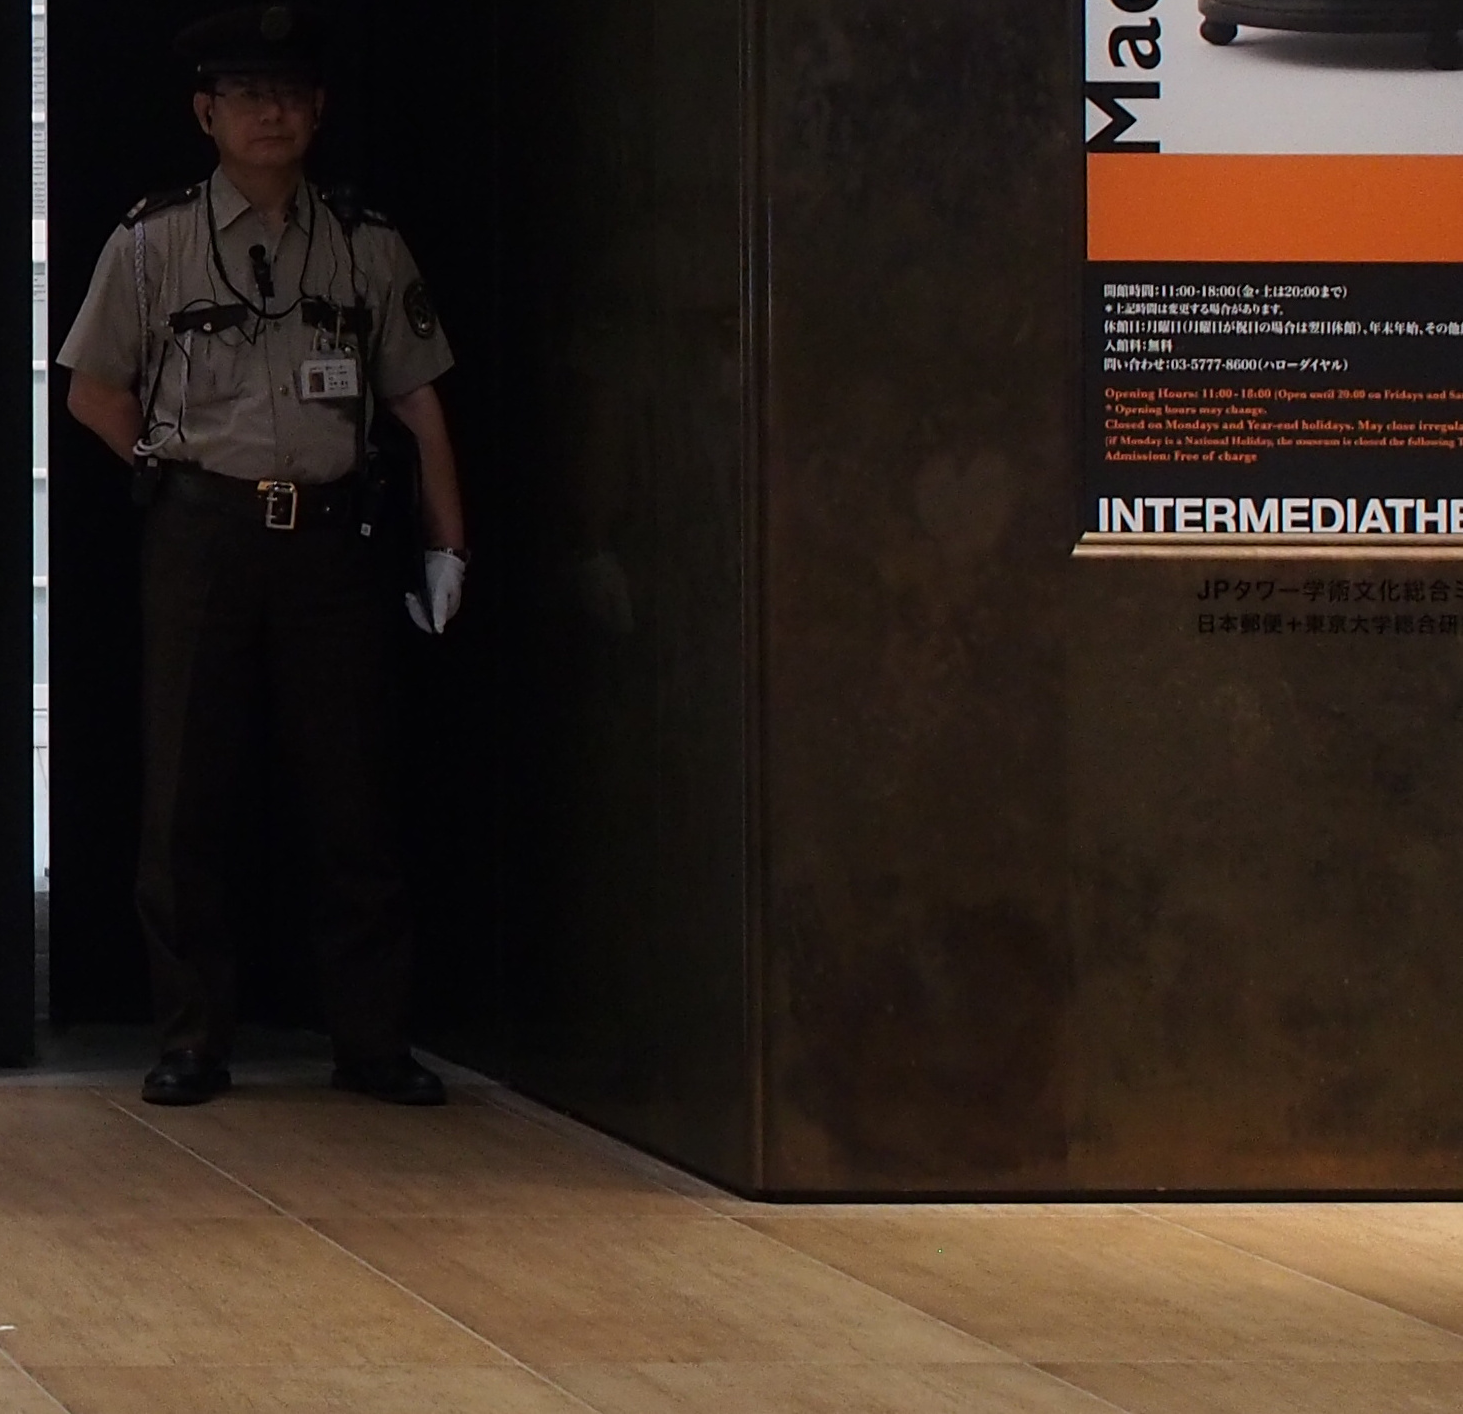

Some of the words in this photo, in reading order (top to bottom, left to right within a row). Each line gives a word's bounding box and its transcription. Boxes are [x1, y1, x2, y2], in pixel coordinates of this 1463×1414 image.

[1104, 388, 1155, 401] Opening
[1115, 404, 1162, 417] Opening
[1104, 419, 1145, 430] Closed
[1165, 419, 1219, 432] Mondays
[1222, 419, 1244, 430] and
[1358, 420, 1384, 432] May
[1174, 451, 1199, 462] Free
[1218, 451, 1258, 463] charge
